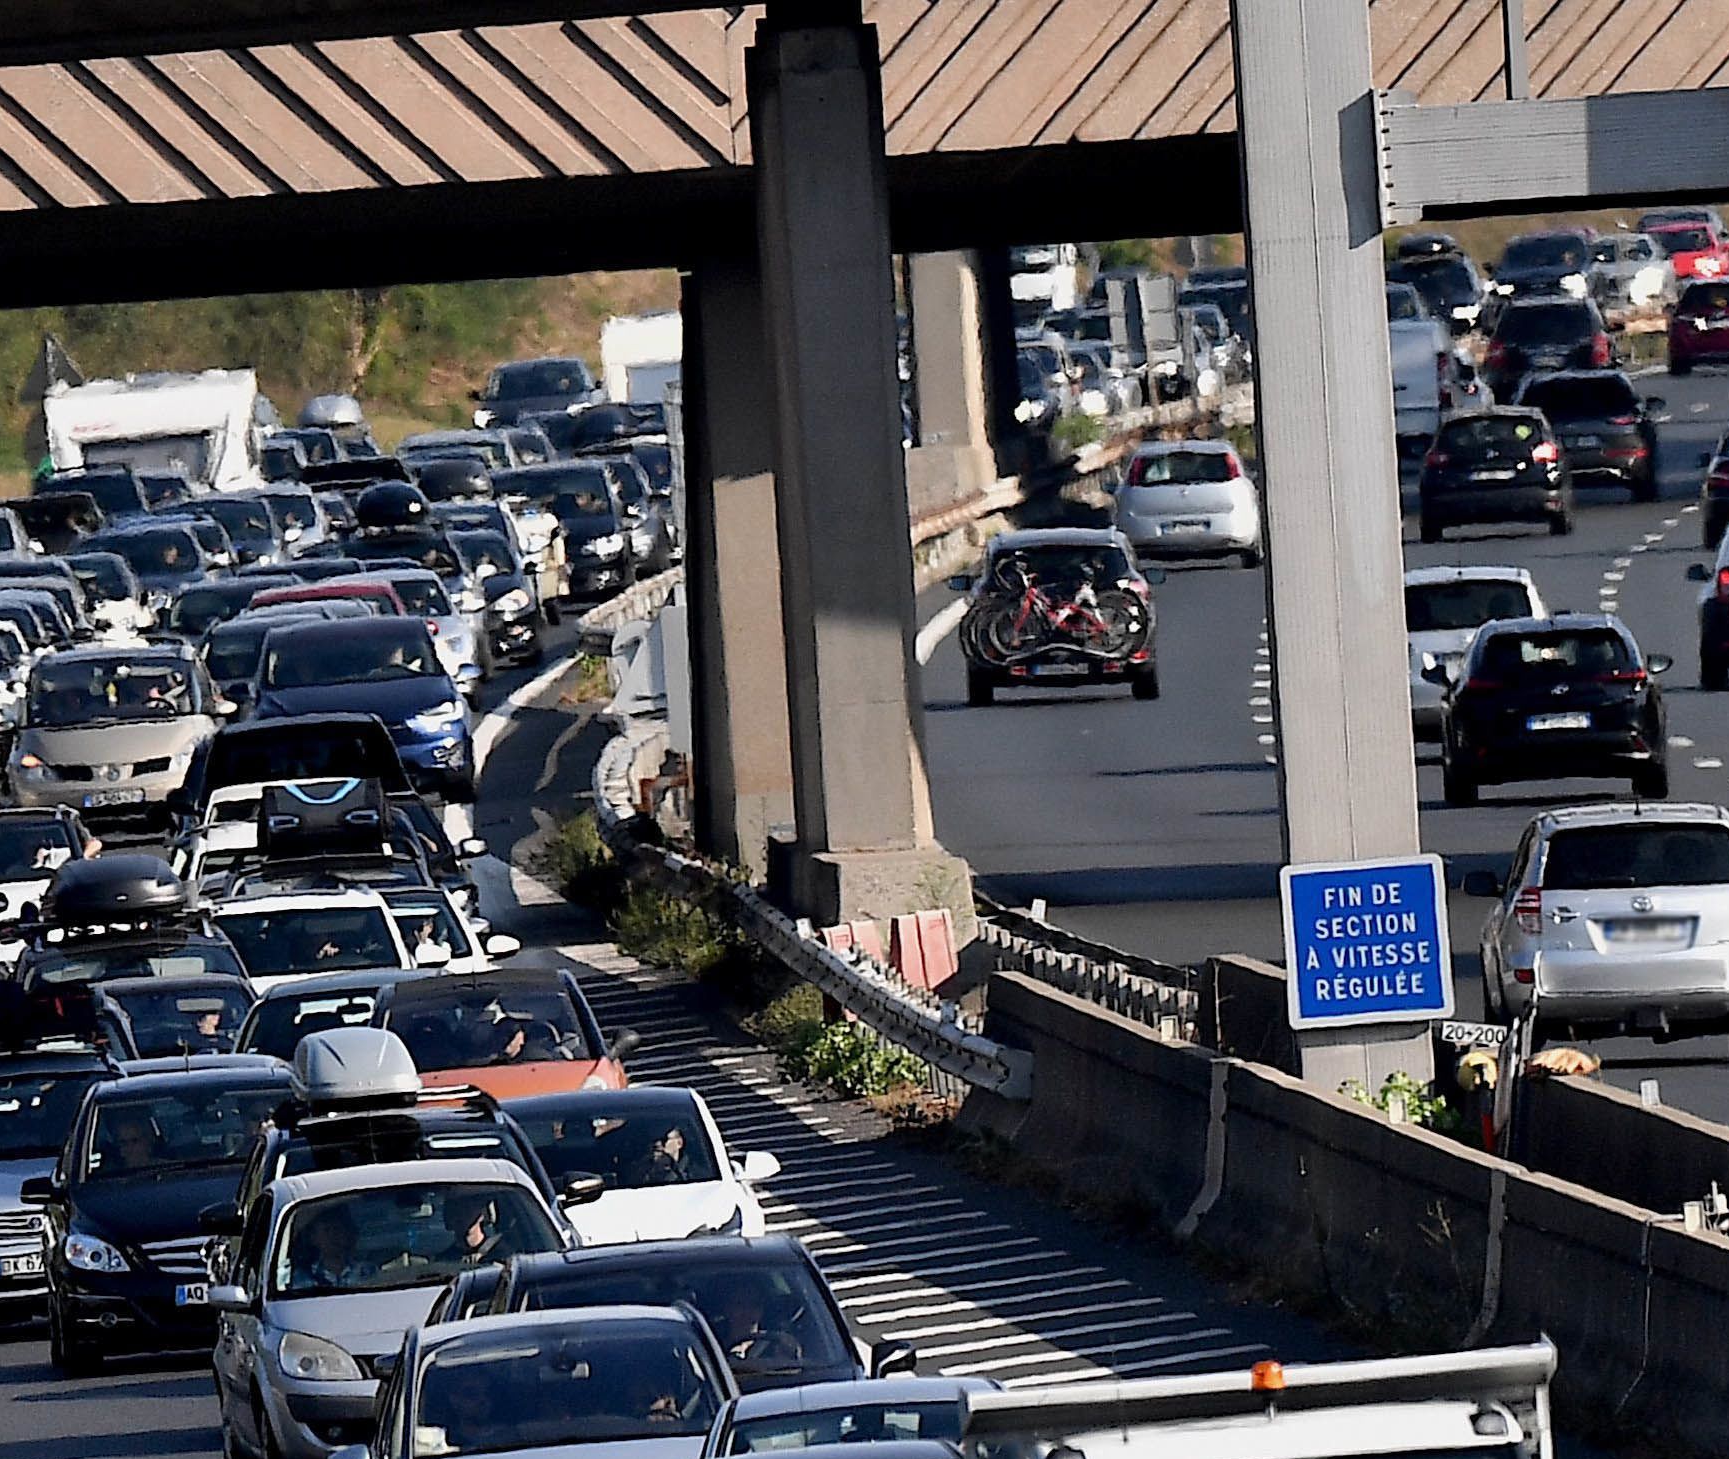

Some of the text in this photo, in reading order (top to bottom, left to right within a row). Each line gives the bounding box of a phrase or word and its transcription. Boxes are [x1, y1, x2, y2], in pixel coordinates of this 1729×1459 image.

[1324, 883, 1402, 909] FIN DE
[1315, 912, 1417, 939] SECTION
[1306, 941, 1431, 970] À VITESSE
[1316, 970, 1424, 1001] RÉGULÉE
